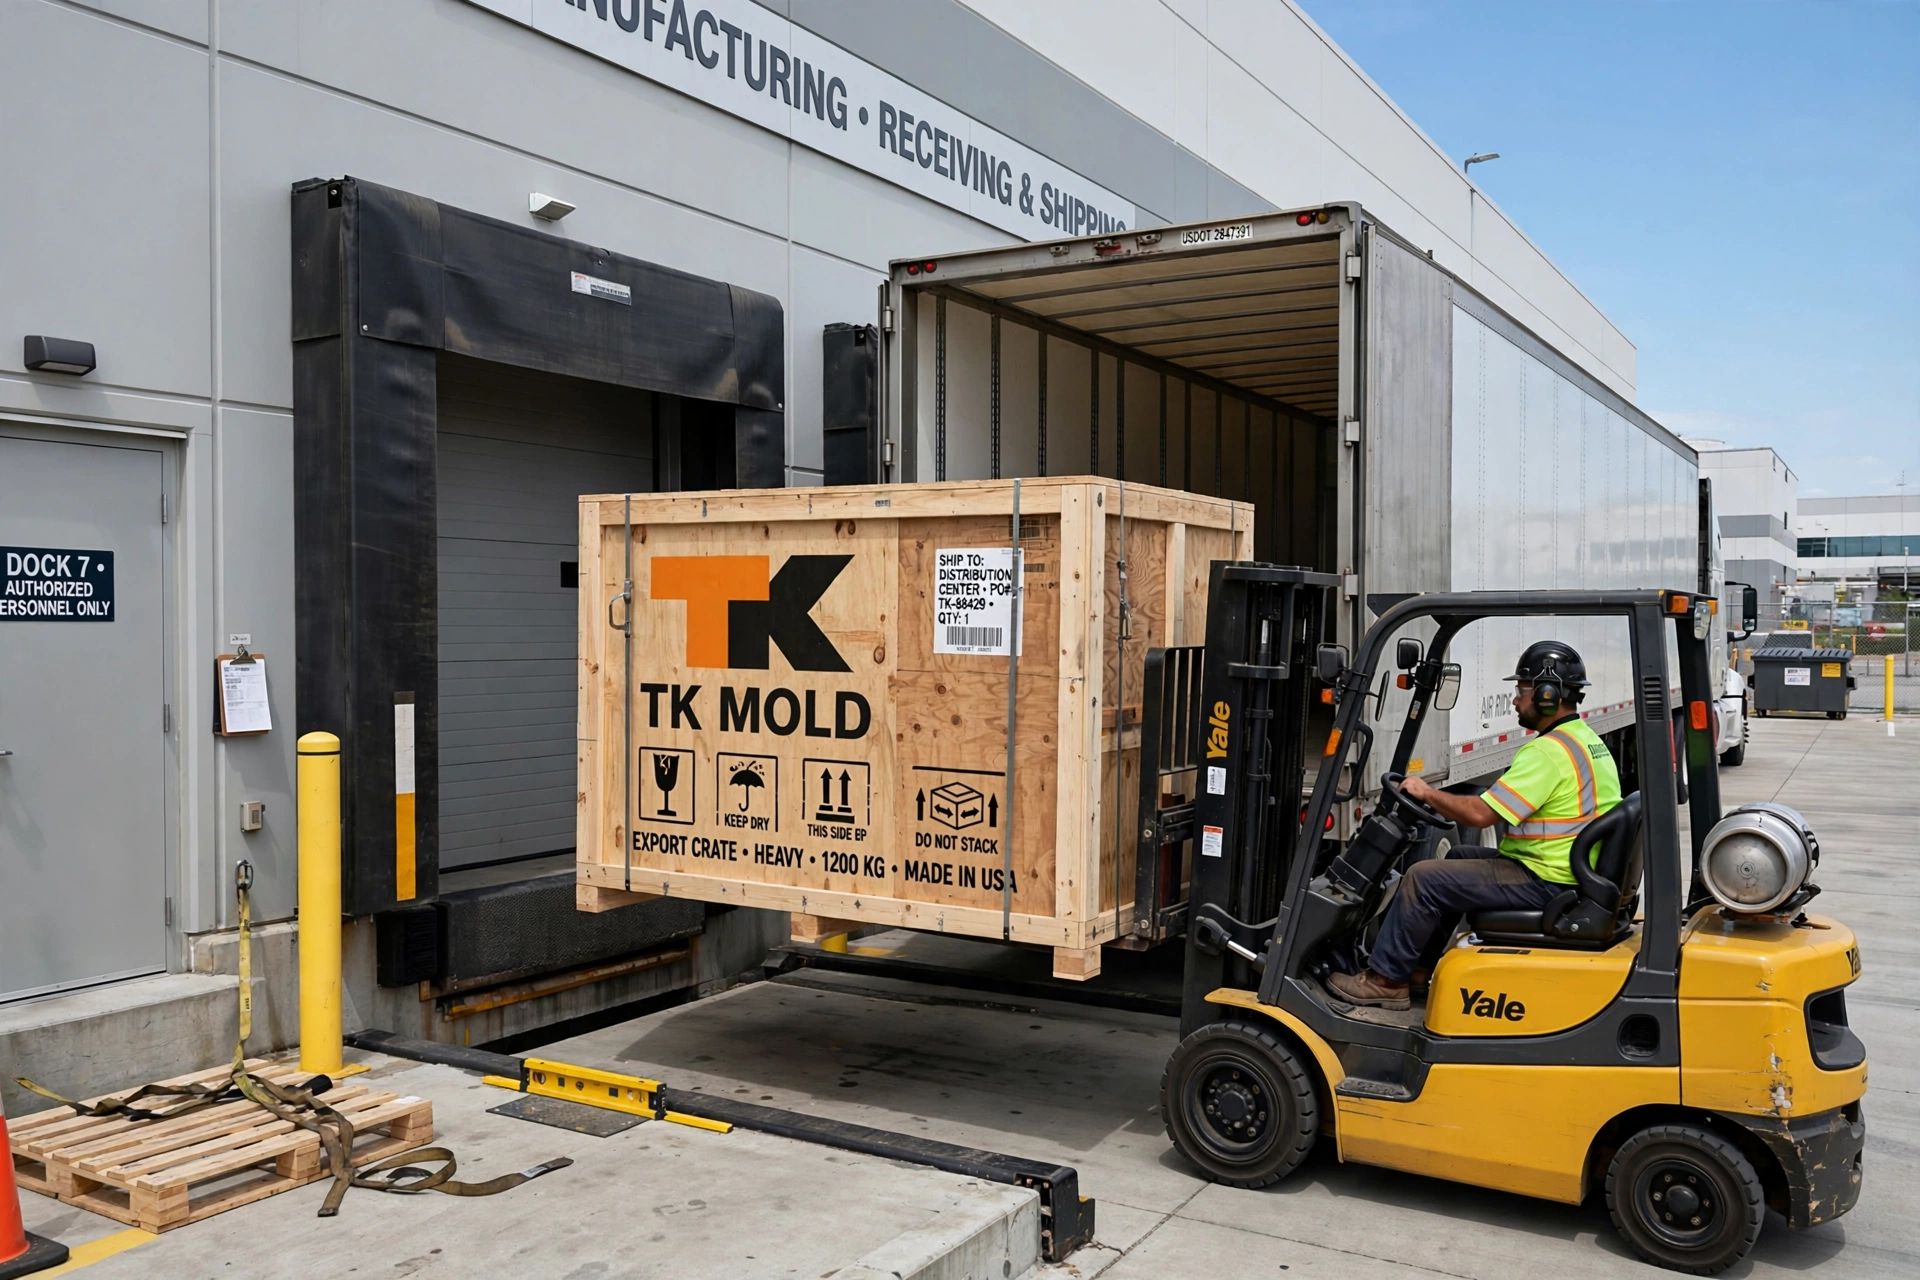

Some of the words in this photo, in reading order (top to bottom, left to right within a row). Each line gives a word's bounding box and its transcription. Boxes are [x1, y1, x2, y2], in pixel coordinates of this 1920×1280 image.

[879, 100, 1012, 206] RECEIVING
[1019, 172, 1035, 217] &
[1182, 229, 1212, 244] USDOT
[1214, 224, 1251, 241] 2847391
[7, 552, 72, 577] DOCK
[78, 555, 91, 578] 7
[940, 555, 963, 566] SHIP
[967, 555, 984, 566] TO:
[939, 569, 1012, 580] DISTRIBUTION
[5, 580, 94, 597] AUTHORIZED
[939, 583, 980, 595] CENTER
[0, 599, 74, 616] ERSONNEL
[76, 600, 111, 616] ONLY
[651, 554, 855, 673] TK
[938, 598, 985, 610] TK-88429
[938, 612, 961, 624] QTY:
[965, 613, 969, 624] 1
[640, 683, 703, 730] TK
[719, 686, 872, 740] MOLD
[1206, 700, 1232, 759] Yale
[724, 813, 748, 828] KEEP
[750, 816, 770, 831] DRY
[807, 823, 829, 838] THIS
[830, 826, 853, 841] SIDE
[915, 832, 932, 848] DO
[934, 834, 959, 851] NOT
[960, 837, 999, 855] STACK
[632, 830, 688, 856] EXPORT
[691, 836, 737, 862] CRATE
[754, 843, 804, 869] HEAVY
[821, 850, 859, 876] 1200
[863, 854, 885, 879] KG
[904, 859, 954, 886] MADE
[958, 865, 976, 889] IN
[981, 867, 1018, 894] USA
[1459, 987, 1526, 1022] Yale
